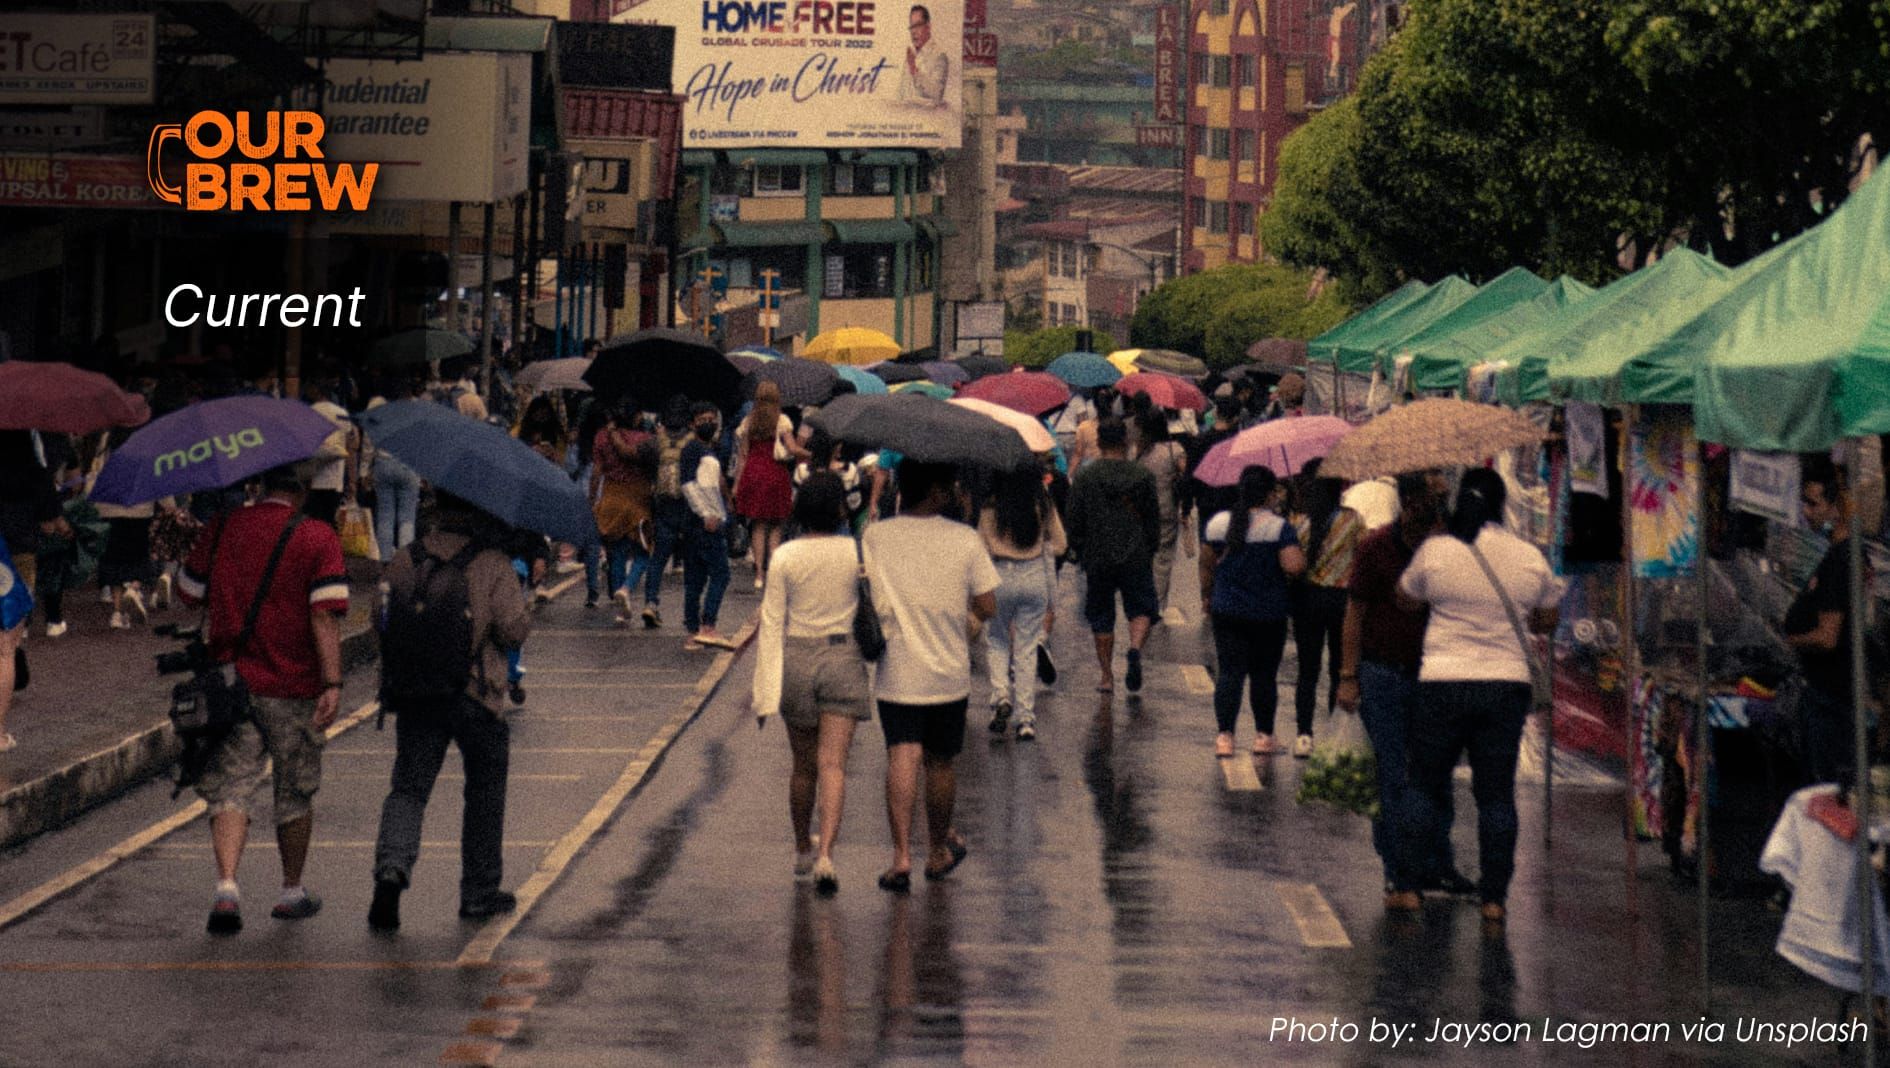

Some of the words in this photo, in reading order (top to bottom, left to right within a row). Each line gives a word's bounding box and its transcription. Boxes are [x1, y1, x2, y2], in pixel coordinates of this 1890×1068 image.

[703, 1, 786, 33] HOME
[793, 1, 875, 34] FREE
[116, 31, 144, 47] 24
[702, 37, 748, 47] GLOBAL
[751, 38, 807, 48] CRUSADE
[811, 39, 841, 48] TOUR
[845, 39, 874, 49] 2022
[685, 61, 765, 122] Hope
[769, 74, 790, 93] in
[790, 52, 896, 103] Christ
[323, 112, 430, 136] uarantee
[1140, 129, 1175, 145] INN
[0, 159, 49, 181] VING
[155, 427, 265, 476] maya
